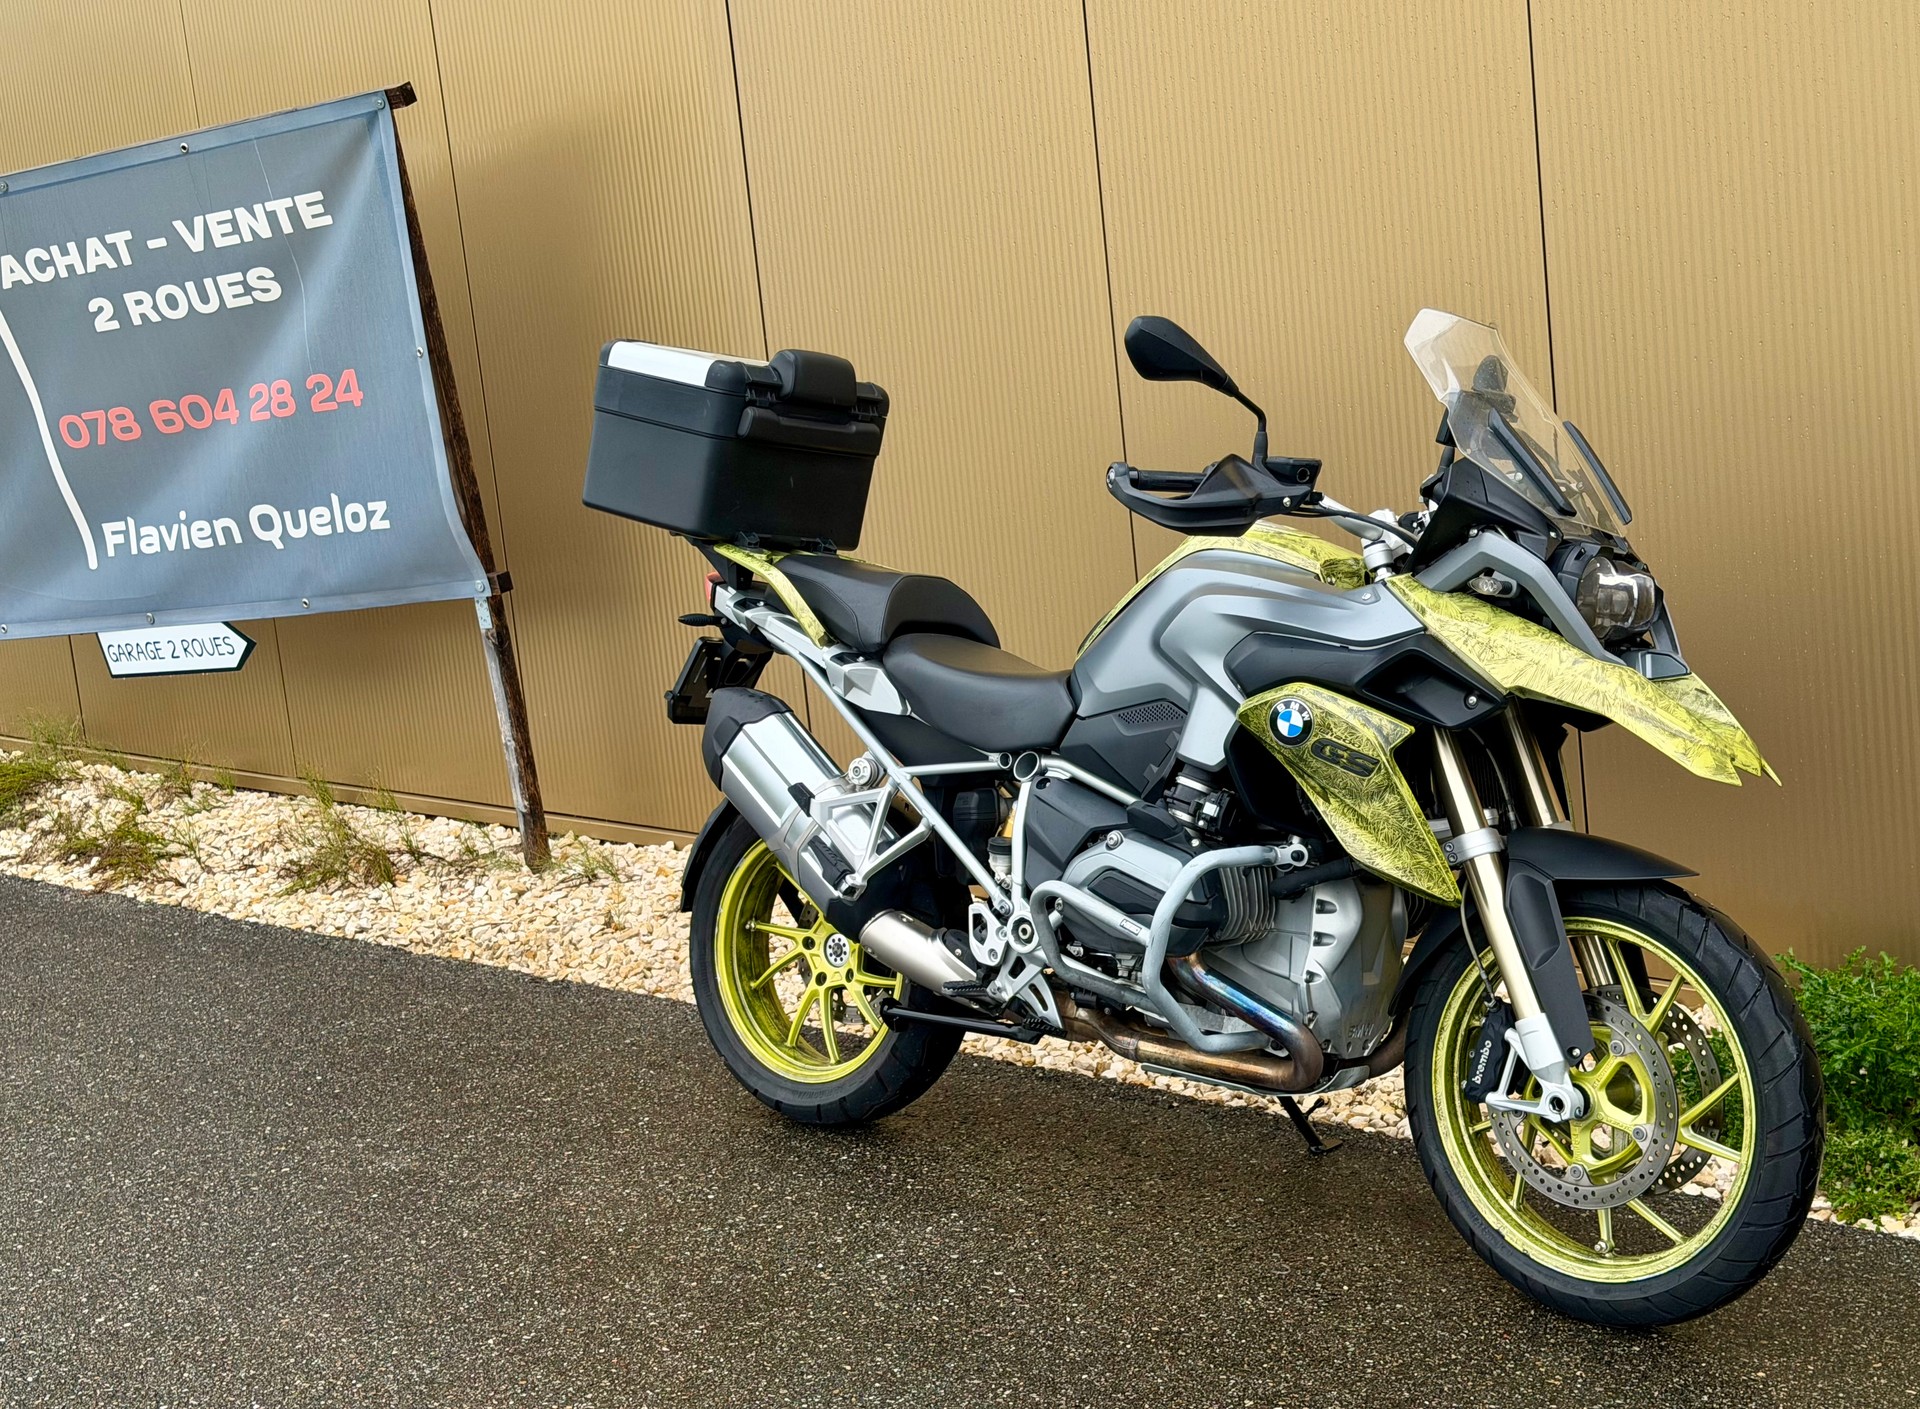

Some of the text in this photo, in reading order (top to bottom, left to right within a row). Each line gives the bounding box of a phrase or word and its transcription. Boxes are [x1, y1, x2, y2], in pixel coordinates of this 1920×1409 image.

[1, 230, 133, 290] ACHAT
[172, 190, 334, 253] VENTE
[88, 266, 282, 333] 2 ROUES
[59, 368, 364, 449] 078 604 28 24
[101, 492, 391, 558] Flavien Queloz
[107, 636, 236, 663] GARAGE 2 ROUES
[1276, 701, 1310, 721] BMW
[1311, 738, 1380, 778] GS
[1471, 1040, 1493, 1085] brembo
